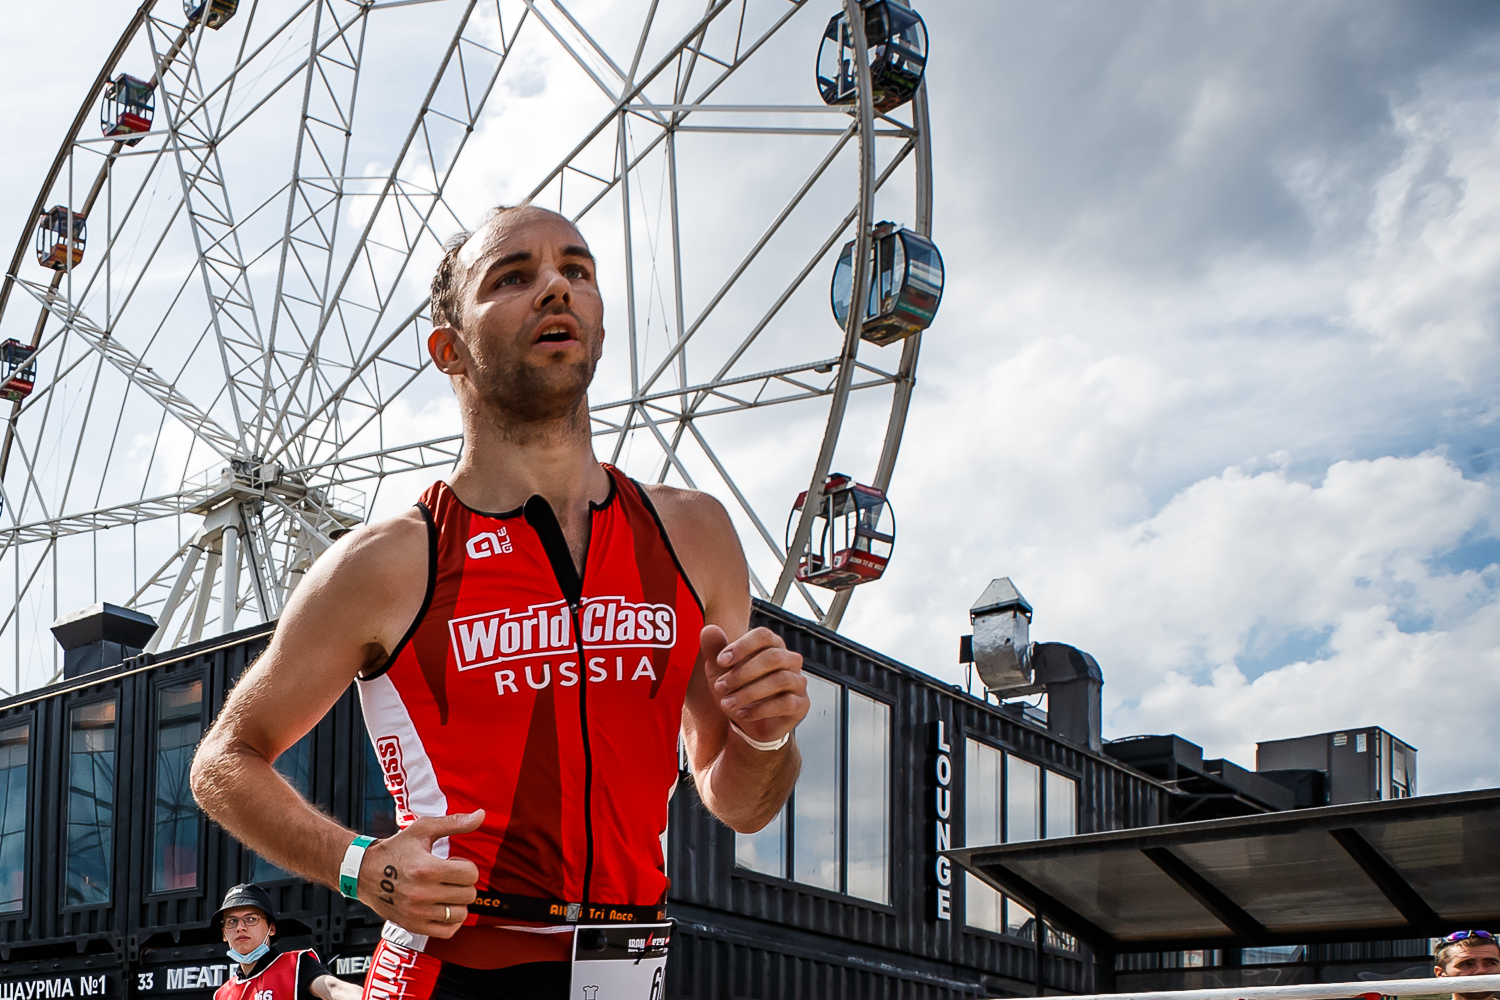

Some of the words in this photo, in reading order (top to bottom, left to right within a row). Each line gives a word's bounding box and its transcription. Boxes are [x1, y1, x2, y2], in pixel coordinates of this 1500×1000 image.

[458, 606, 571, 662] World
[581, 602, 671, 642] Class
[494, 655, 657, 696] RUSSIA
[935, 720, 951, 920] LOUNGE
[379, 864, 398, 906] 601
[475, 898, 501, 907] ace
[550, 904, 583, 918] Alti
[589, 908, 604, 919] Tri
[137, 972, 154, 991] 33
[166, 964, 228, 990] MEAT
[336, 956, 373, 975] MEA
[80, 975, 106, 996] №1
